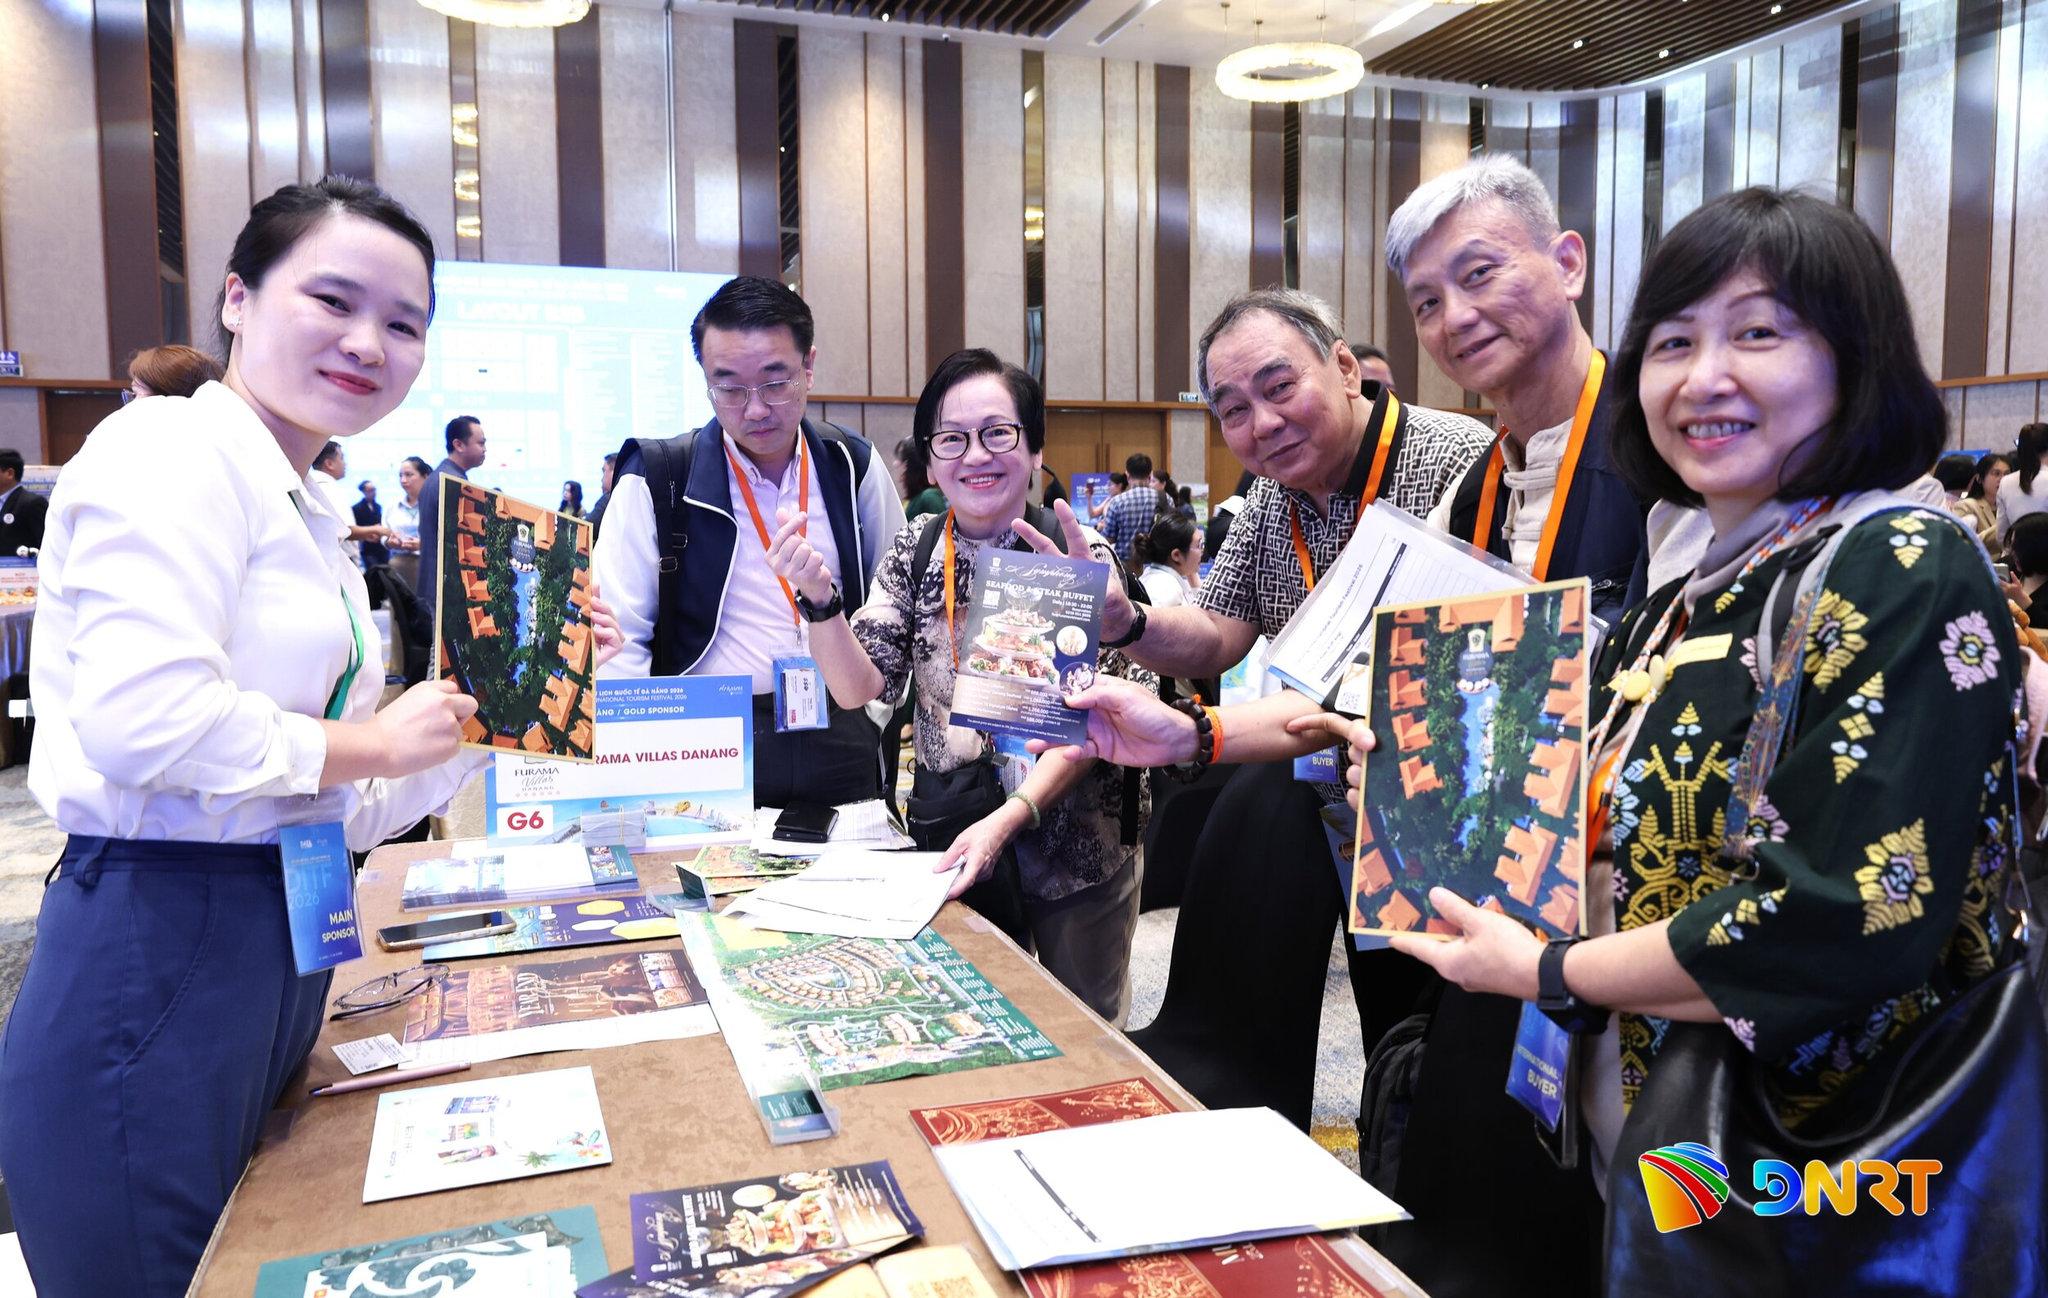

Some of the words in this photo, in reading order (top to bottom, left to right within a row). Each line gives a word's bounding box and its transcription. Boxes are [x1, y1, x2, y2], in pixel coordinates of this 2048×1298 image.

[1063, 590, 1094, 602] BUFFET
[623, 707, 646, 716] GOLD
[648, 706, 685, 715] SPONSOR
[594, 753, 631, 765] RAMA
[635, 750, 677, 763] VILLAS
[681, 747, 739, 760] DANANG
[1312, 756, 1334, 767] BUYER
[514, 767, 560, 777] FURAMA
[507, 811, 544, 830] G6
[329, 909, 353, 925] MAIN
[321, 927, 356, 943] SPONSOR
[1527, 1067, 1557, 1098] BUYER
